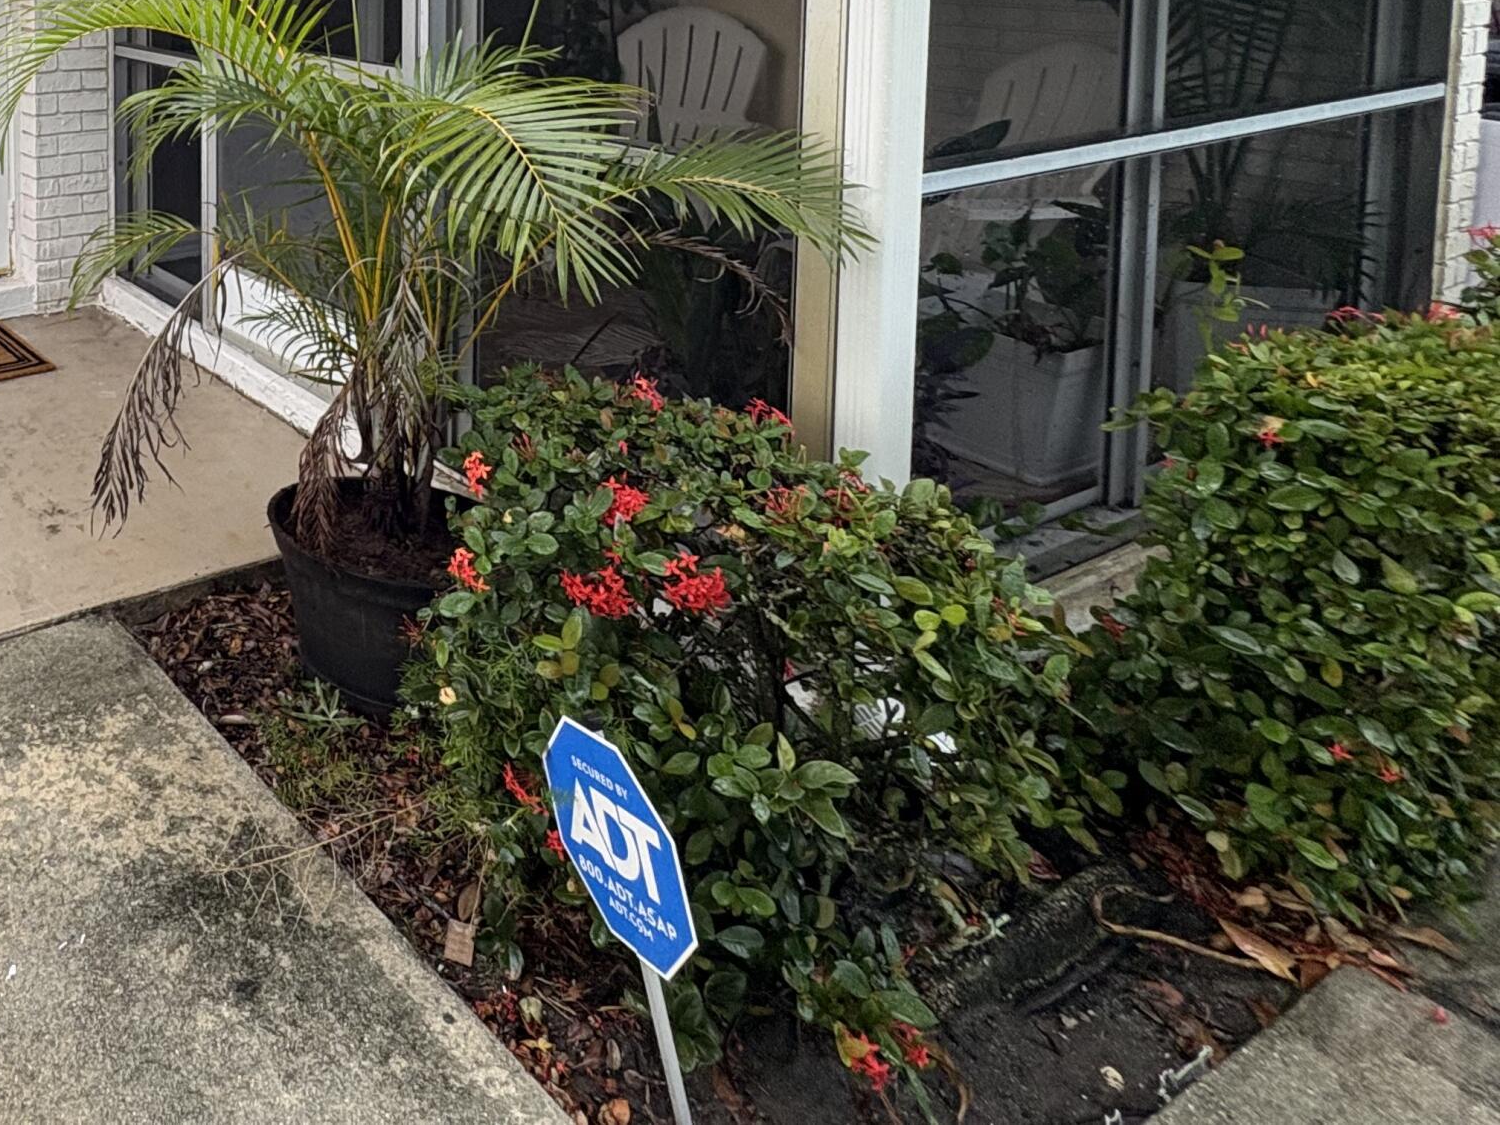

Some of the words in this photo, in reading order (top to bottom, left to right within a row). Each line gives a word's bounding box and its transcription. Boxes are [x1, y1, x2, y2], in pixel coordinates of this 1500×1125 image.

[571, 755, 614, 791] SECURED
[615, 783, 628, 801] BY
[570, 776, 661, 905] ADT
[579, 854, 677, 941] 800.ADT.ASAP
[609, 896, 654, 942] ADT.COM
